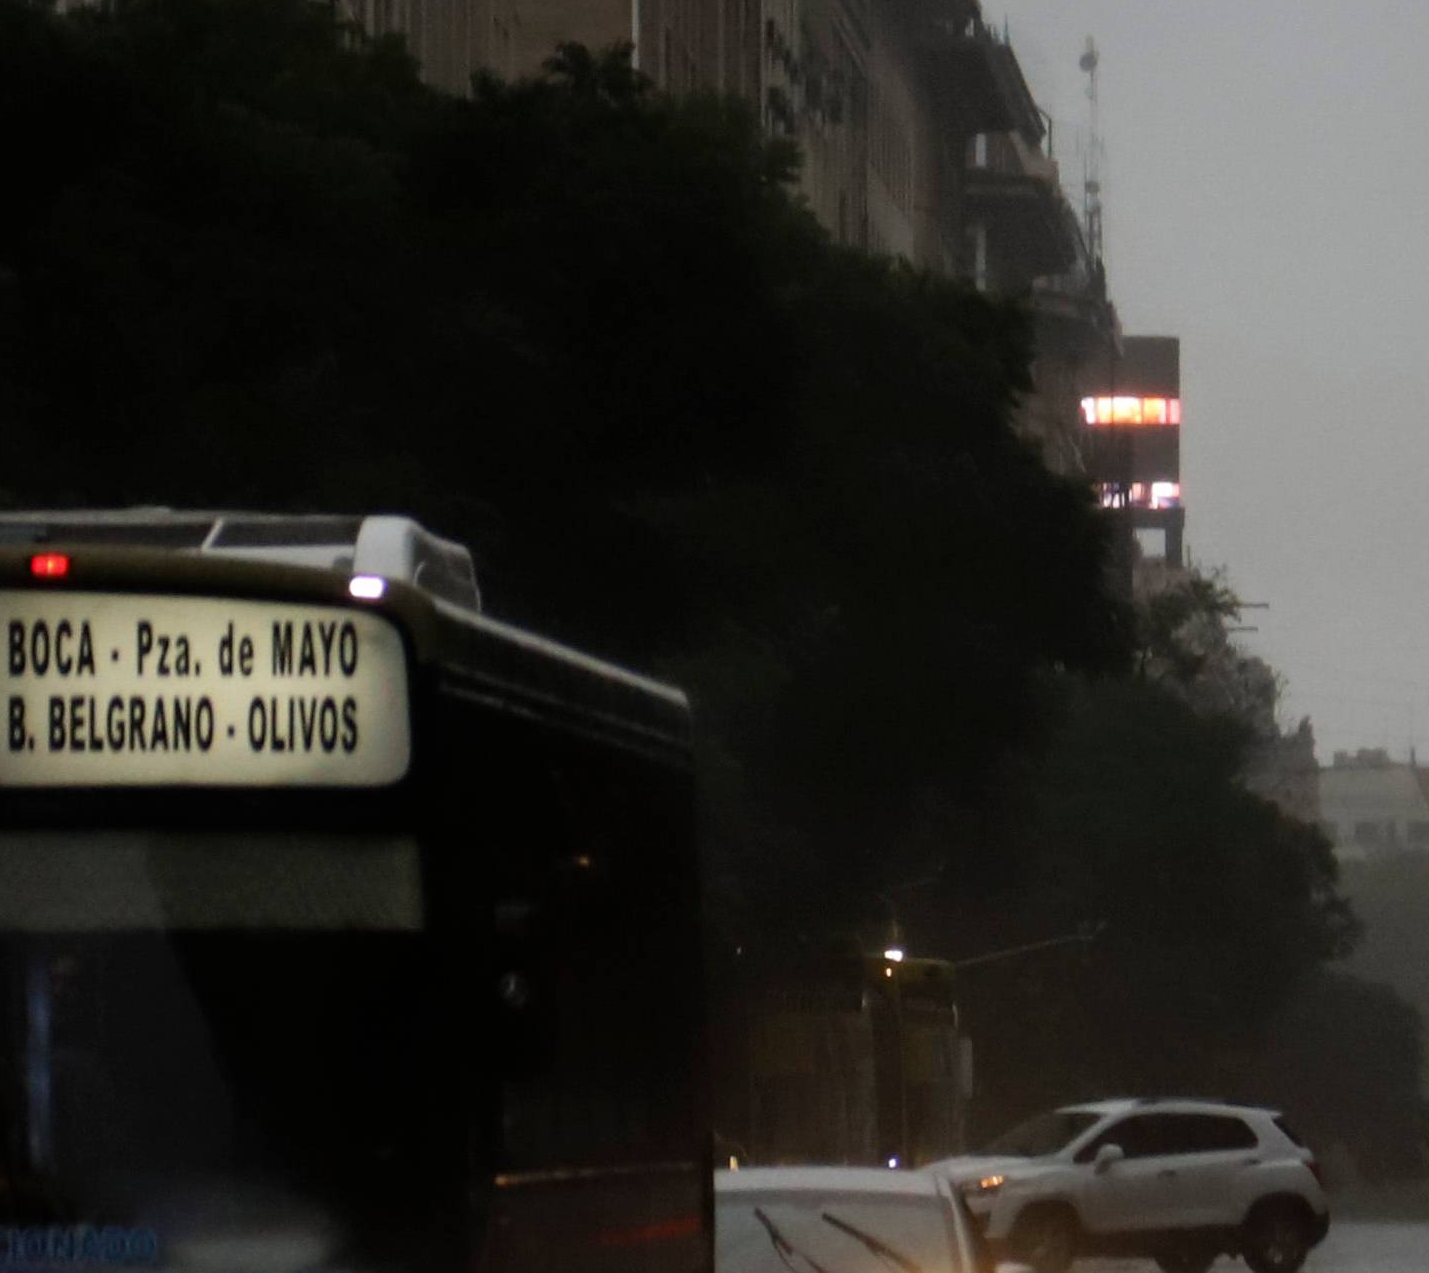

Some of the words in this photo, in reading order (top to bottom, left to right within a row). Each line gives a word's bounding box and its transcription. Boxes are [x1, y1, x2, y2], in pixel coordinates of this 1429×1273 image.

[7, 620, 95, 677] BOCA
[136, 621, 202, 677] Pza.
[218, 622, 254, 677] de
[271, 621, 358, 677] MAYO
[8, 696, 35, 752] B.
[48, 696, 214, 752] BELGRANO
[247, 697, 358, 752] OLIVOS
